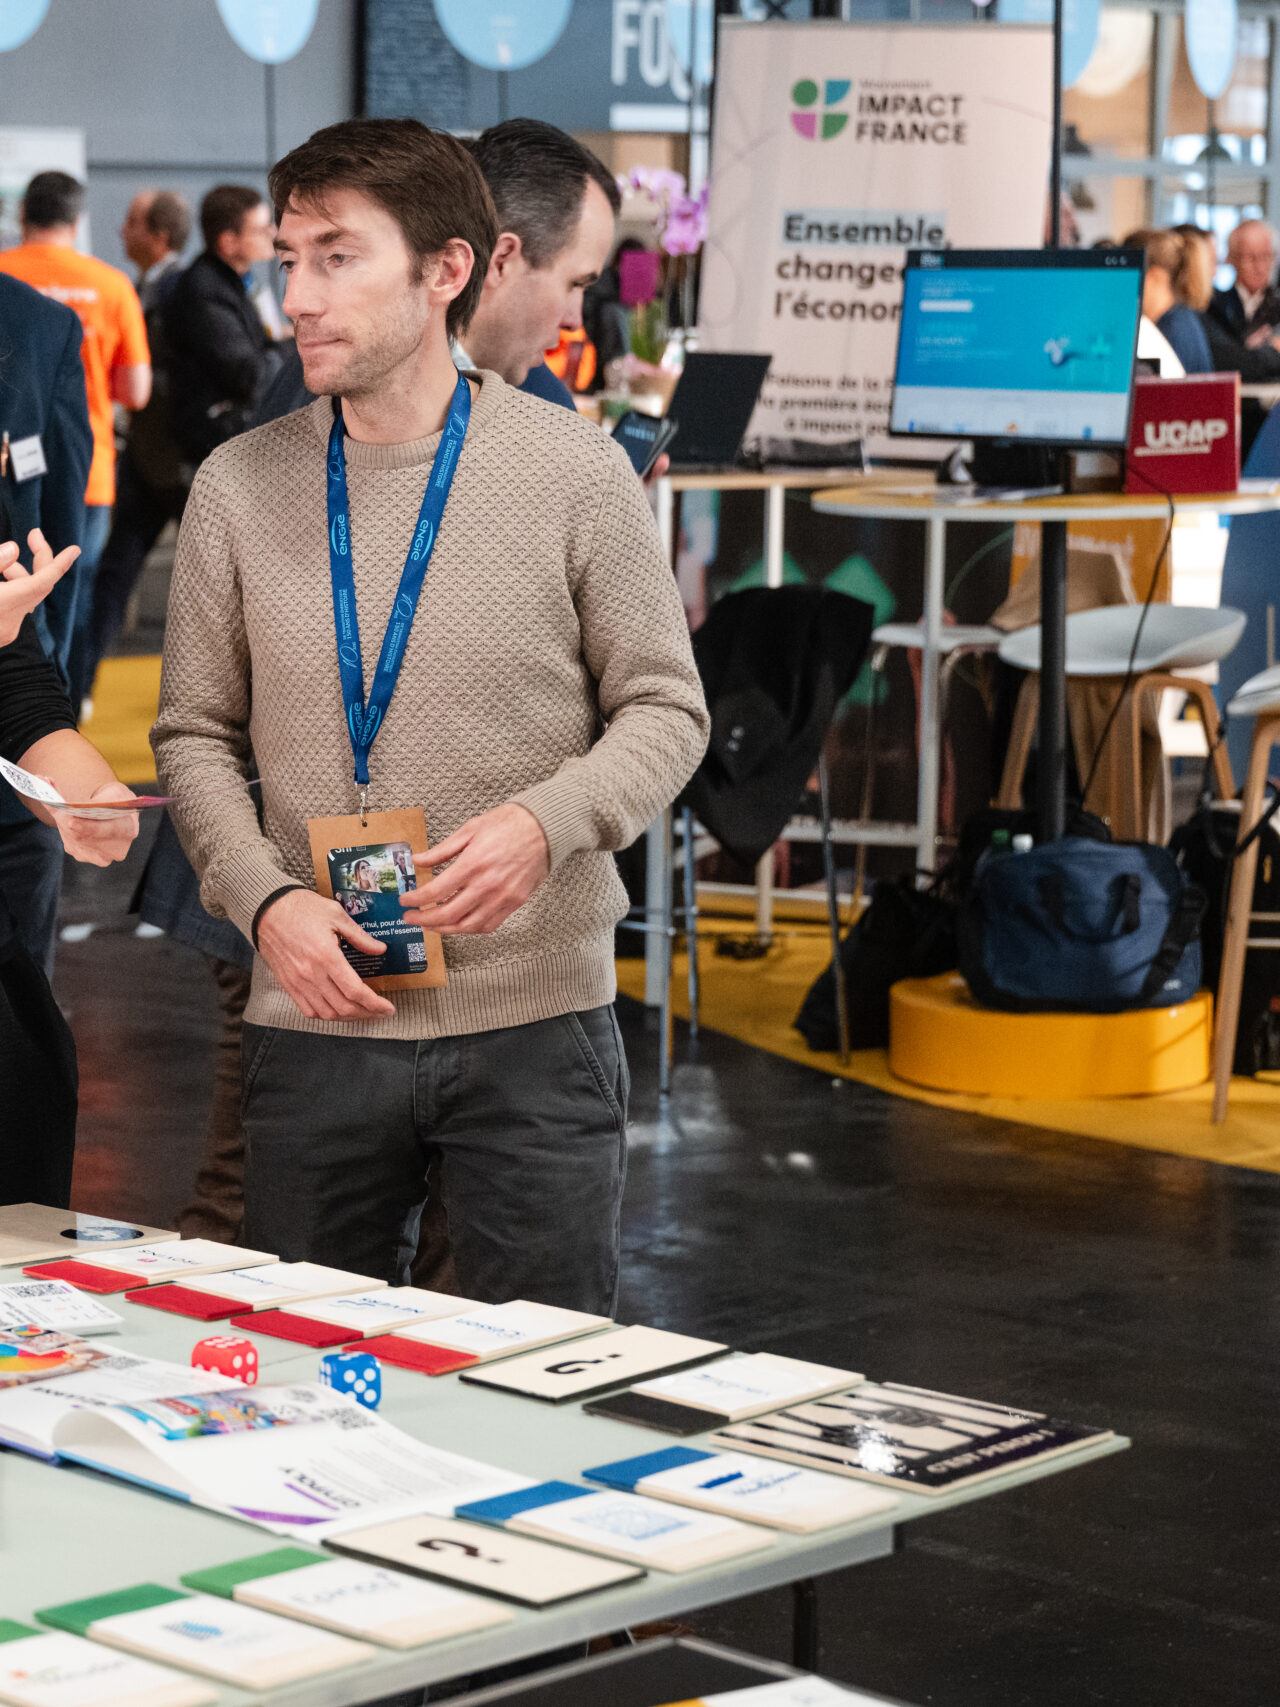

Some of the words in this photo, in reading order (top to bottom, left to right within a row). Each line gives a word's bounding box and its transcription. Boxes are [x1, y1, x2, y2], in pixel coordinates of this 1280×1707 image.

[857, 93, 964, 117] IMPACT
[854, 120, 968, 145] FRANCE
[784, 213, 952, 250] Ensemble,
[776, 253, 904, 289] change
[380, 920, 395, 928] pour
